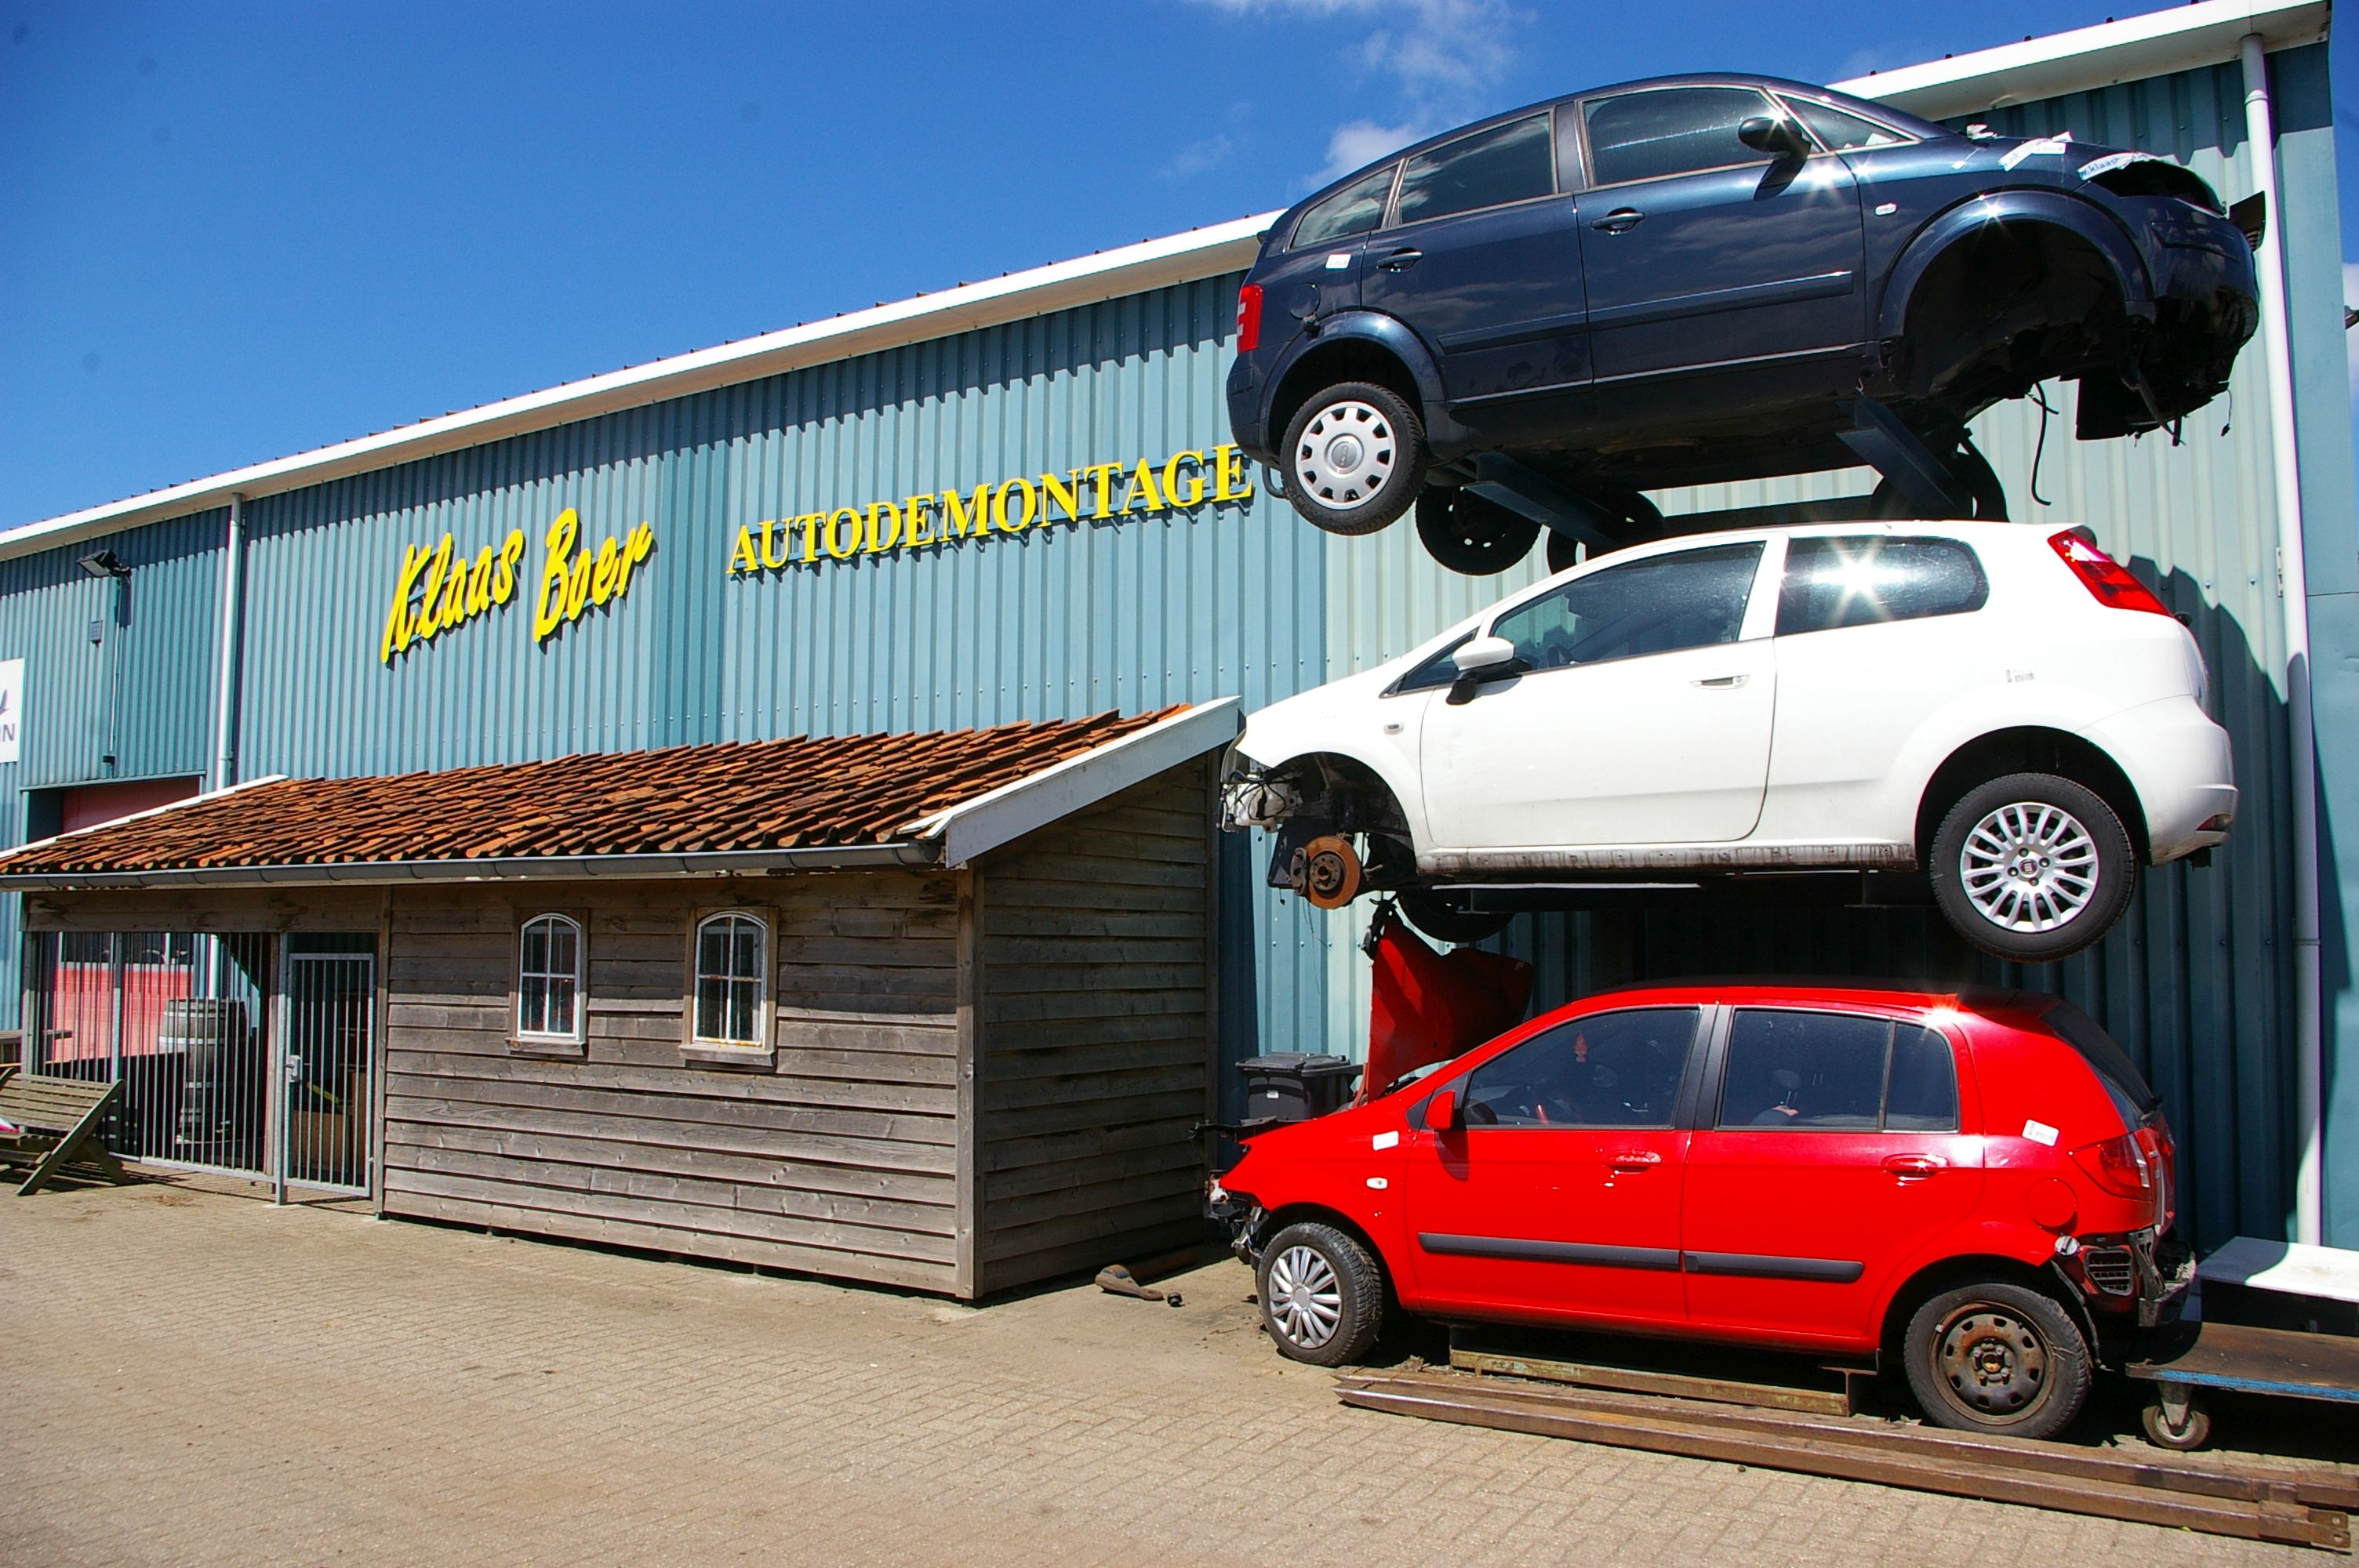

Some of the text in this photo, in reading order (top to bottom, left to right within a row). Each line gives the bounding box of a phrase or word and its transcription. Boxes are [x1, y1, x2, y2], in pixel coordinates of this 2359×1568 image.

[726, 444, 1253, 574] AUTODEMONTAGE
[381, 508, 652, 662] Klaas Boer
